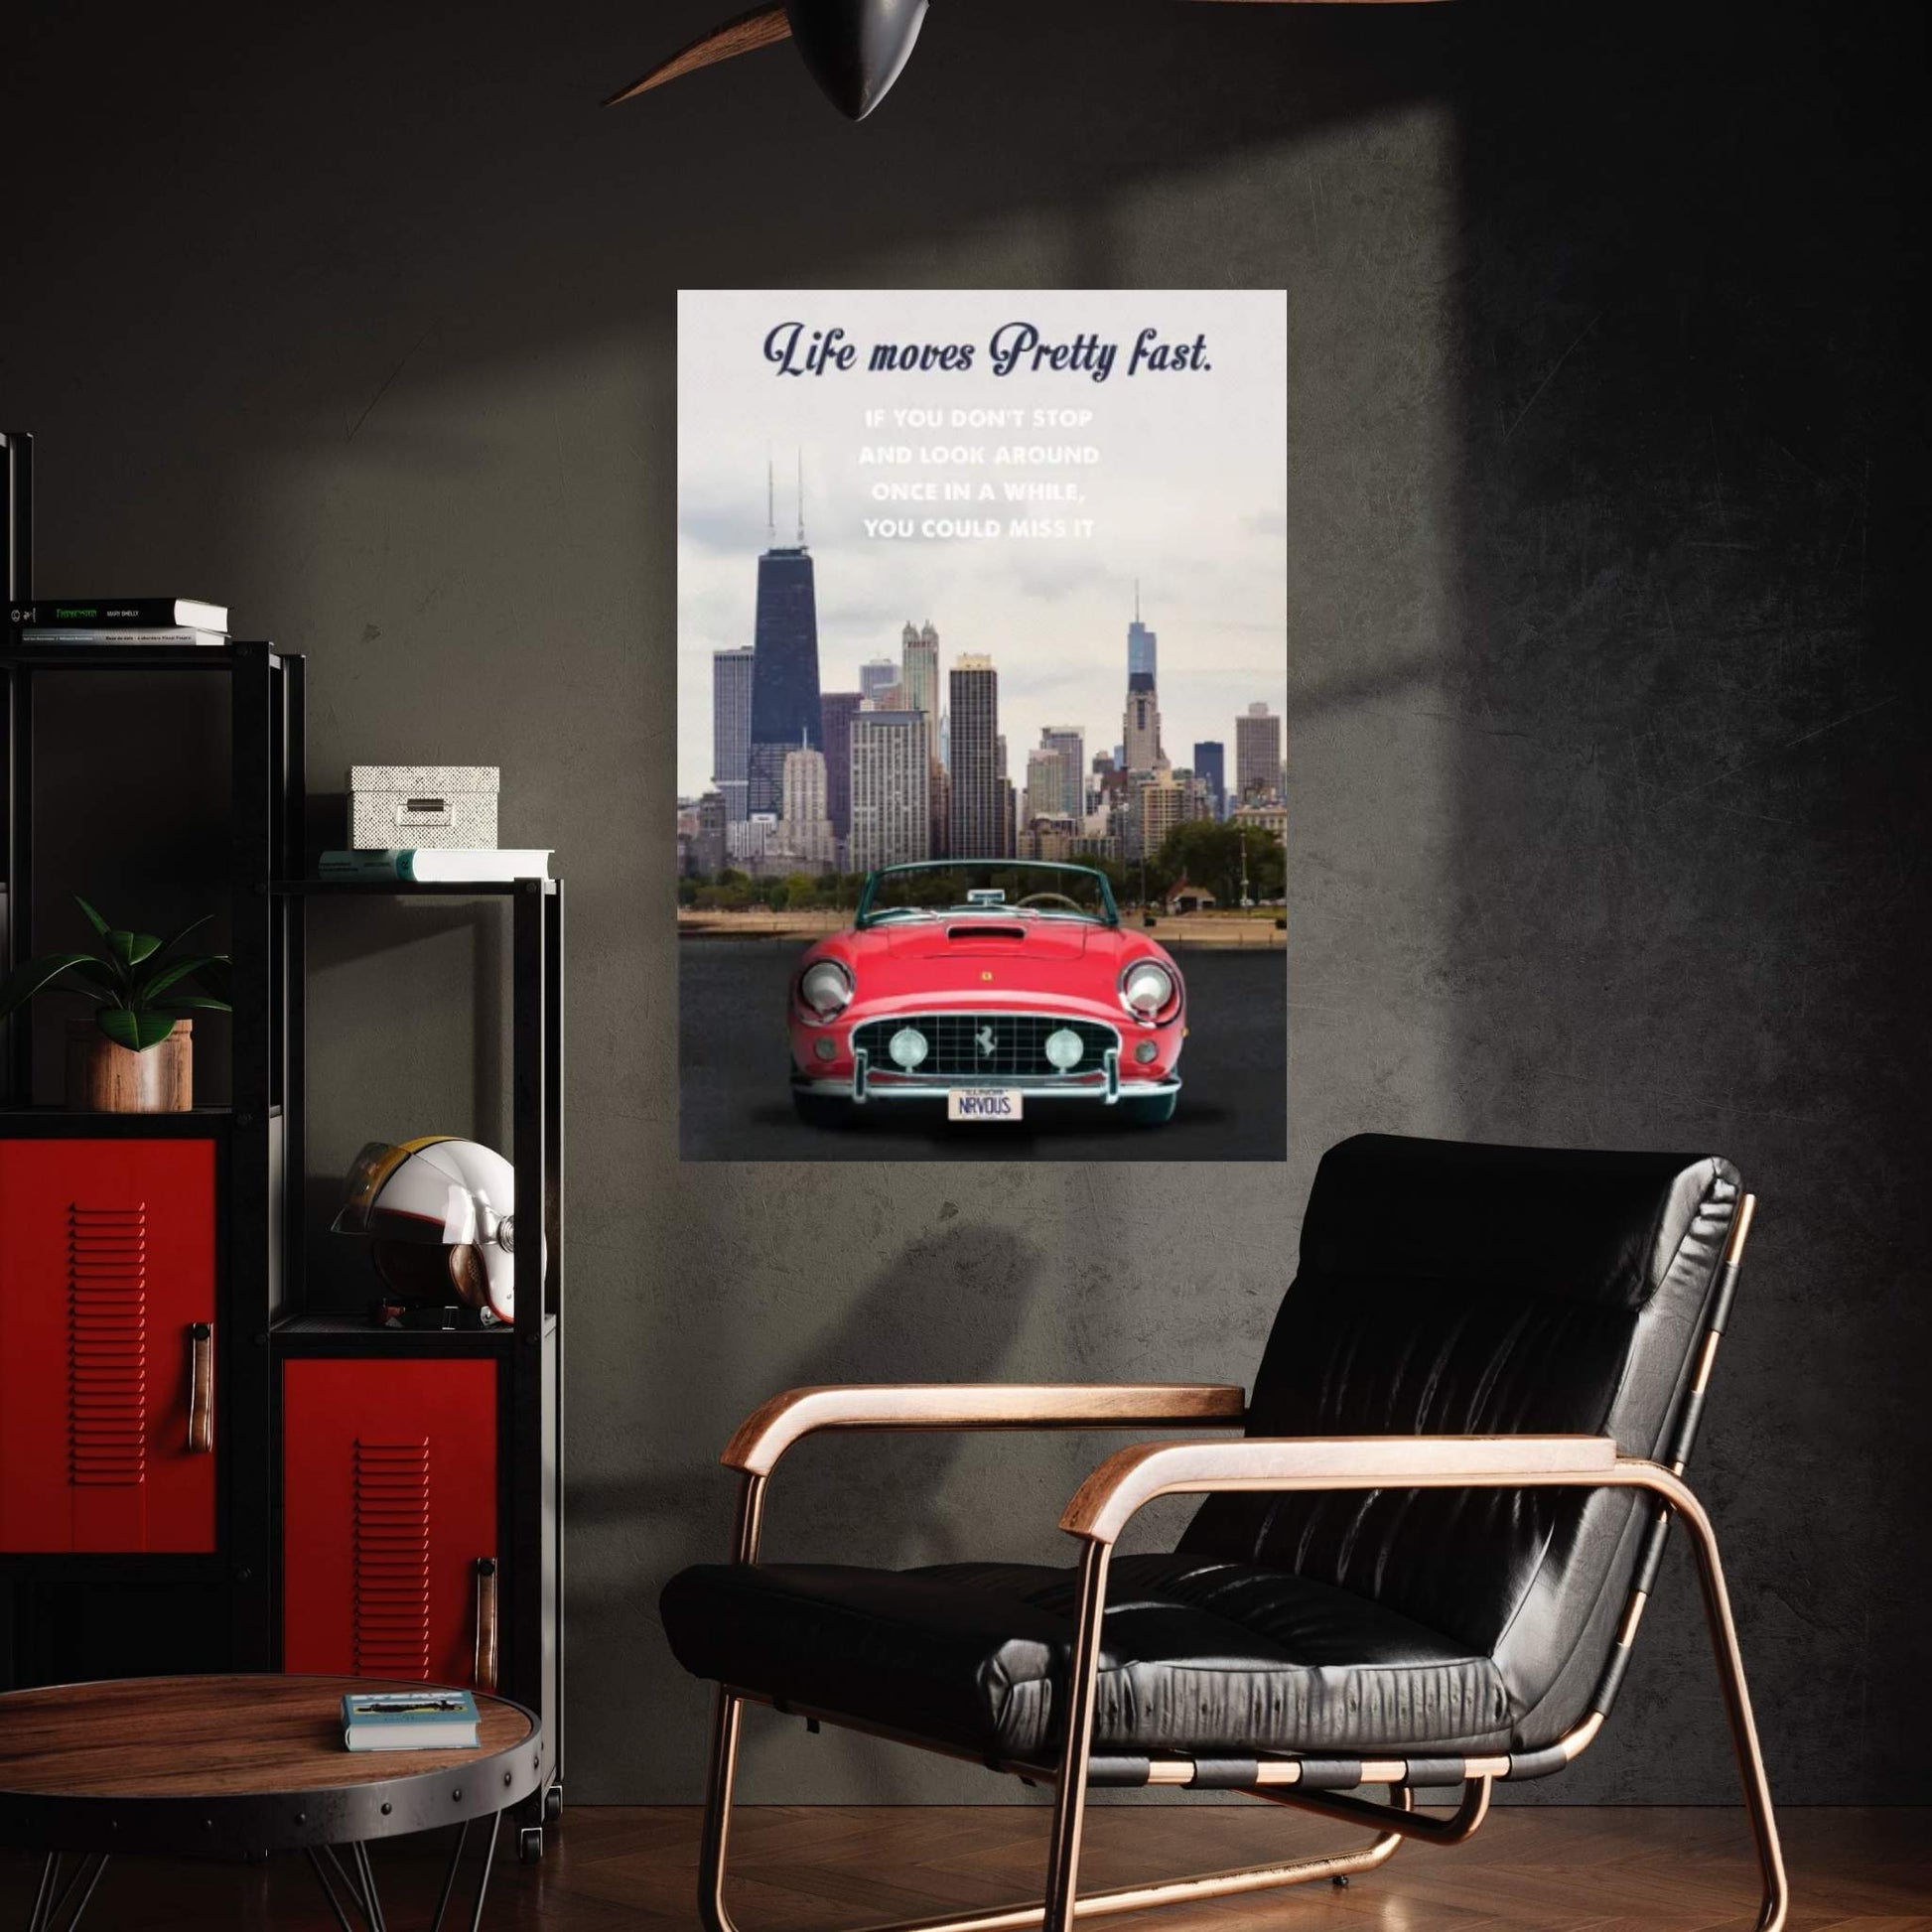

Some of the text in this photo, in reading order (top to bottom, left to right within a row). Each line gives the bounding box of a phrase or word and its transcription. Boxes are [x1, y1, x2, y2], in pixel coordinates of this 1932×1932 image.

[762, 322, 1212, 383] Life moves Pretty fast.
[865, 408, 1093, 428] IF YOU DON'T STOP
[858, 445, 1100, 465] AND LOOK AROUND
[871, 482, 1086, 505] ONCE IN A WHILE,
[863, 518, 1094, 538] YOU COULD MISS IT
[959, 1096, 1012, 1115] NRVOUS
